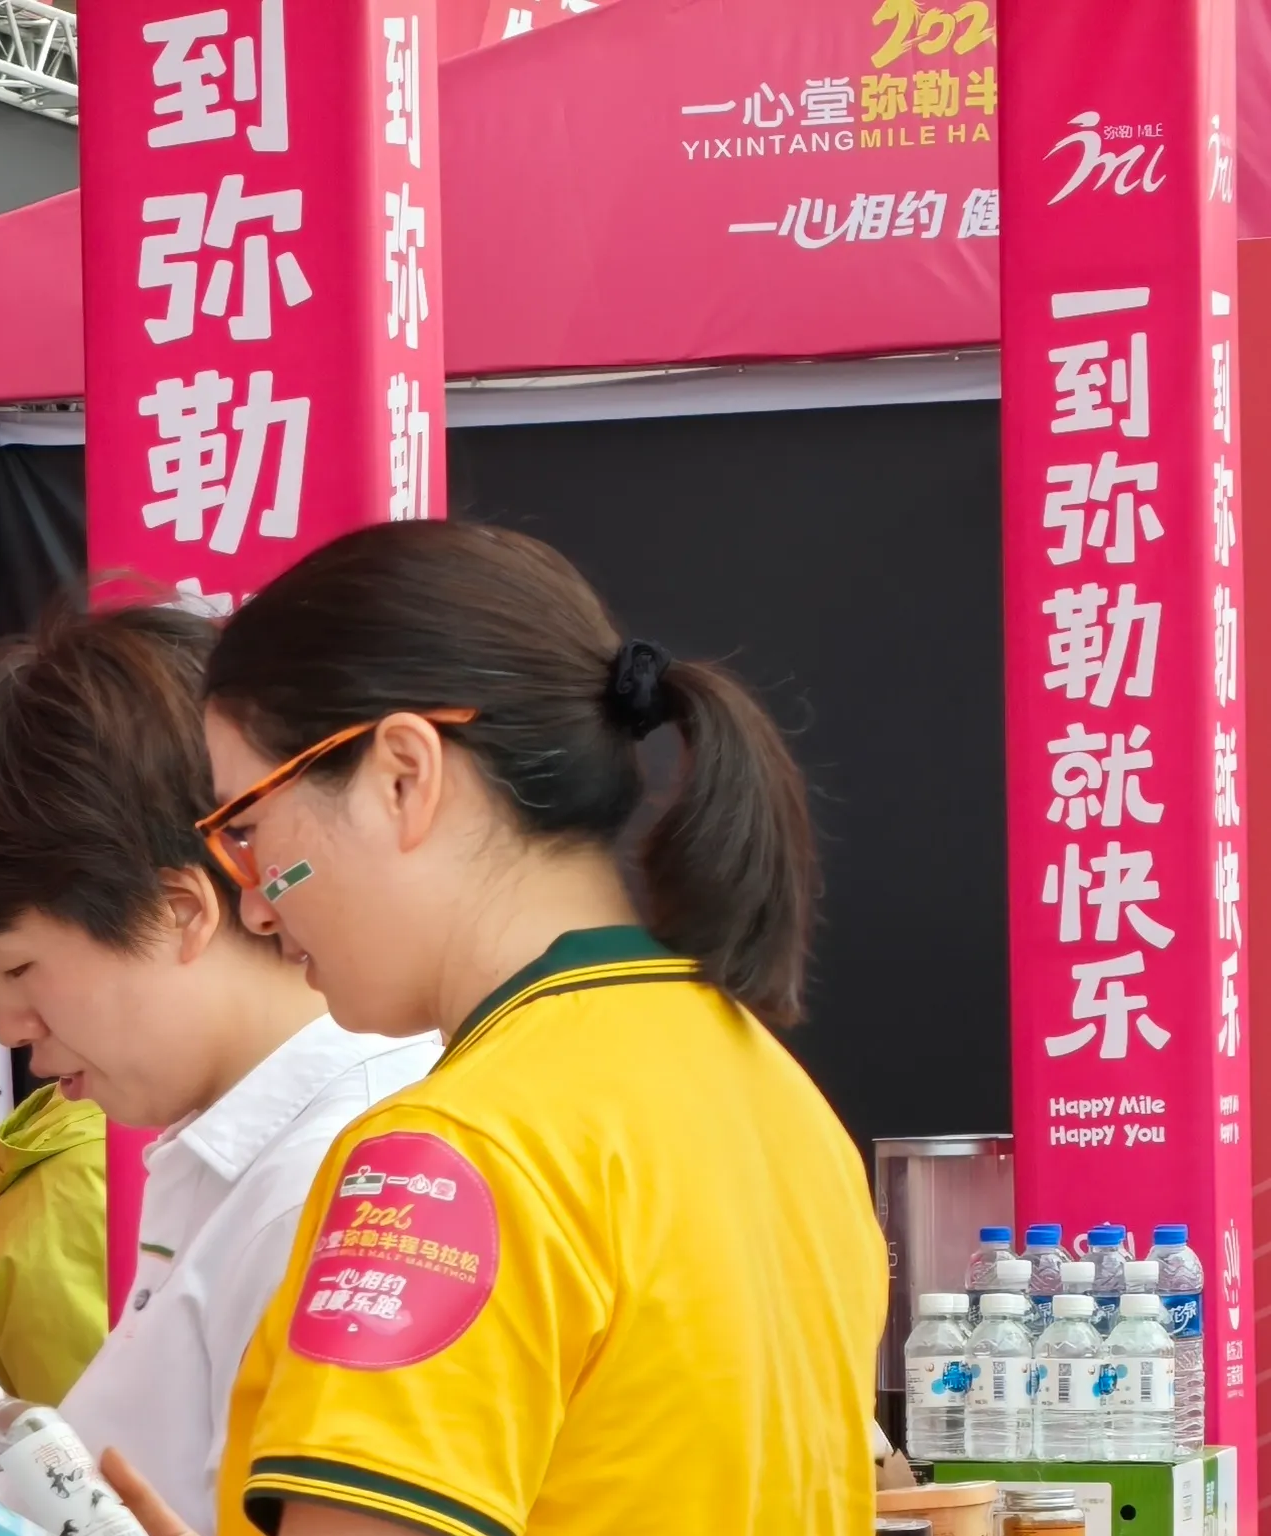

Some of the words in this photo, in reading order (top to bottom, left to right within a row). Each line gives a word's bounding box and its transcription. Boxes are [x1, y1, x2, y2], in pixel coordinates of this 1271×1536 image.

[870, 0, 998, 69] 202
[681, 130, 854, 160] YIXINTANG
[860, 125, 937, 149] MILE
[728, 189, 948, 249] 一心相约
[138, 0, 312, 600] 到弥勒
[1035, 286, 1176, 1059] 一到弥勒就快乐
[1210, 289, 1242, 1058] 一到弥勒就快乐
[1049, 1094, 1115, 1120] Happy
[1118, 1095, 1166, 1116] Mile
[1049, 1123, 1116, 1147] Happy
[1123, 1123, 1166, 1147] You
